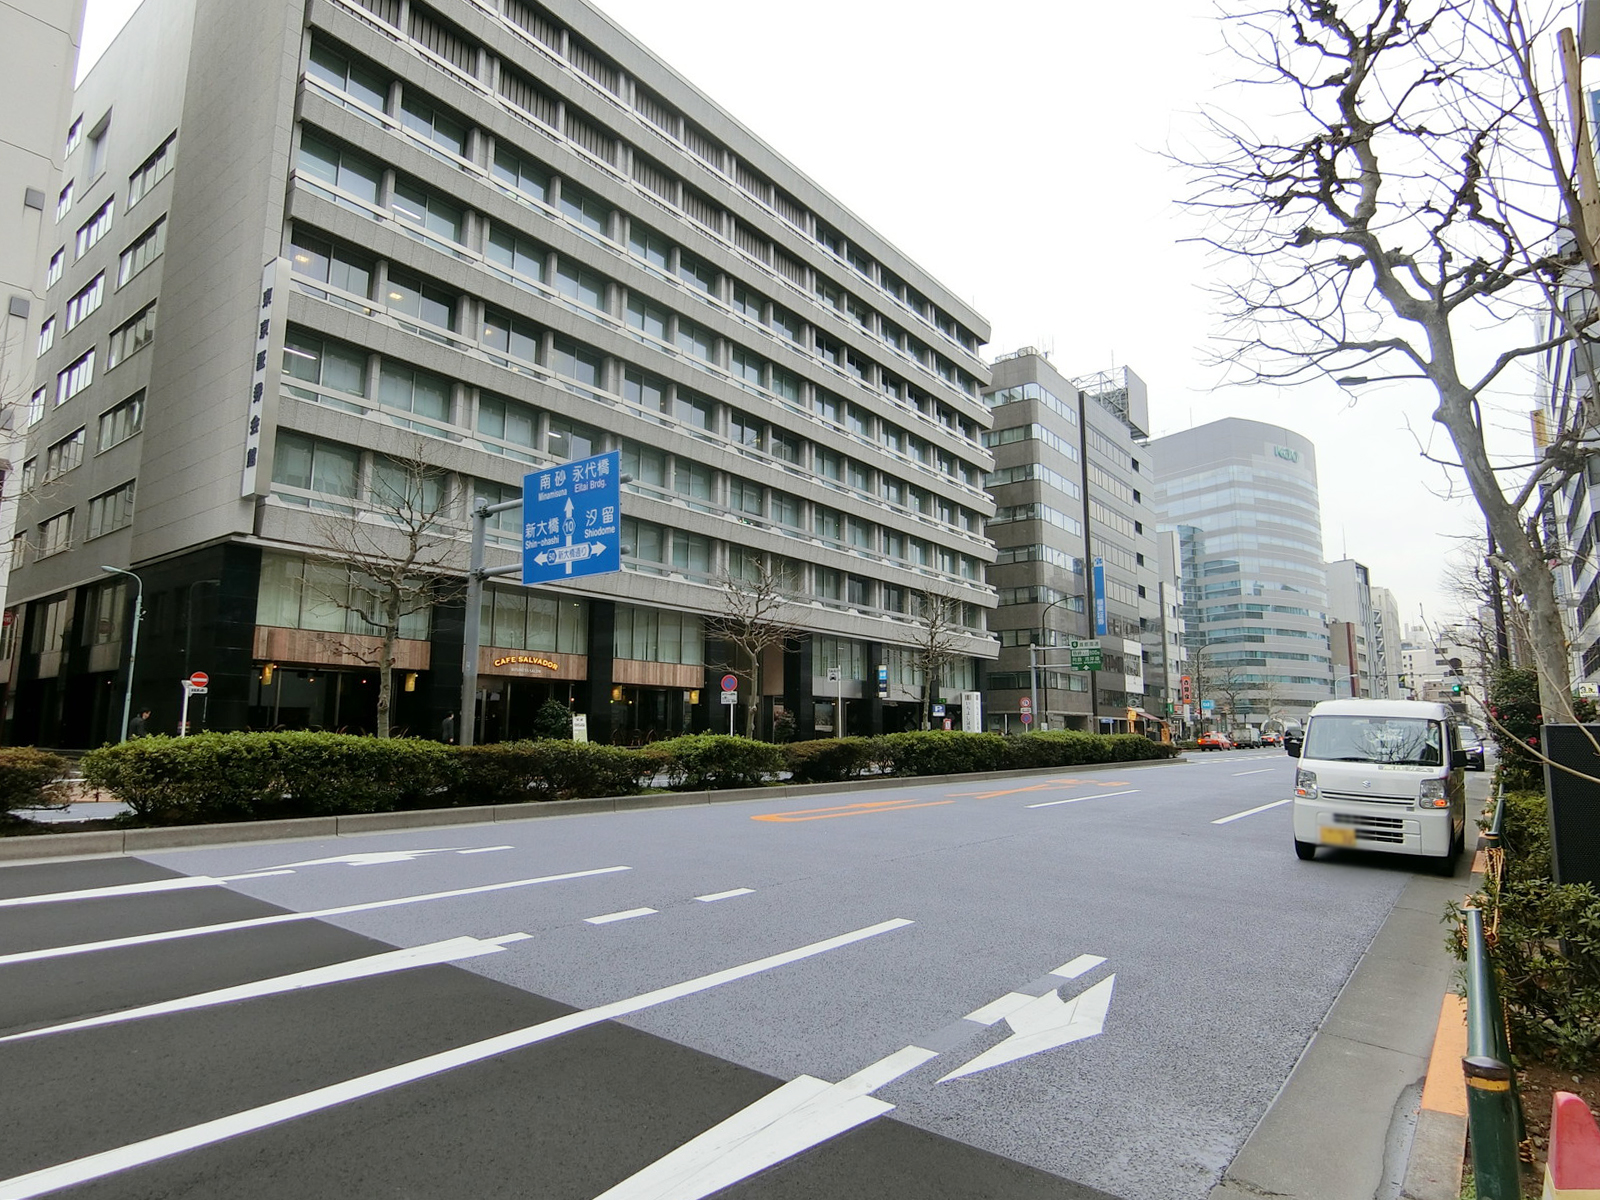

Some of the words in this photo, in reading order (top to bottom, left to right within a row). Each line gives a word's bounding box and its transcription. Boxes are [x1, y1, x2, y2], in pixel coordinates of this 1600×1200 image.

[540, 469, 567, 491] 南砂
[572, 458, 610, 483] 永代橋
[574, 480, 589, 493] Eitai
[590, 478, 607, 491] Brdg.
[586, 506, 615, 527] 汐留
[525, 516, 560, 538] 新大橋
[564, 521, 574, 533] 10
[584, 525, 616, 539] Shiodome
[525, 534, 560, 550] Shin-ohashi
[558, 547, 587, 560] 新大橋通り
[494, 656, 516, 667] CAFE
[518, 656, 559, 671] SALVADOR
